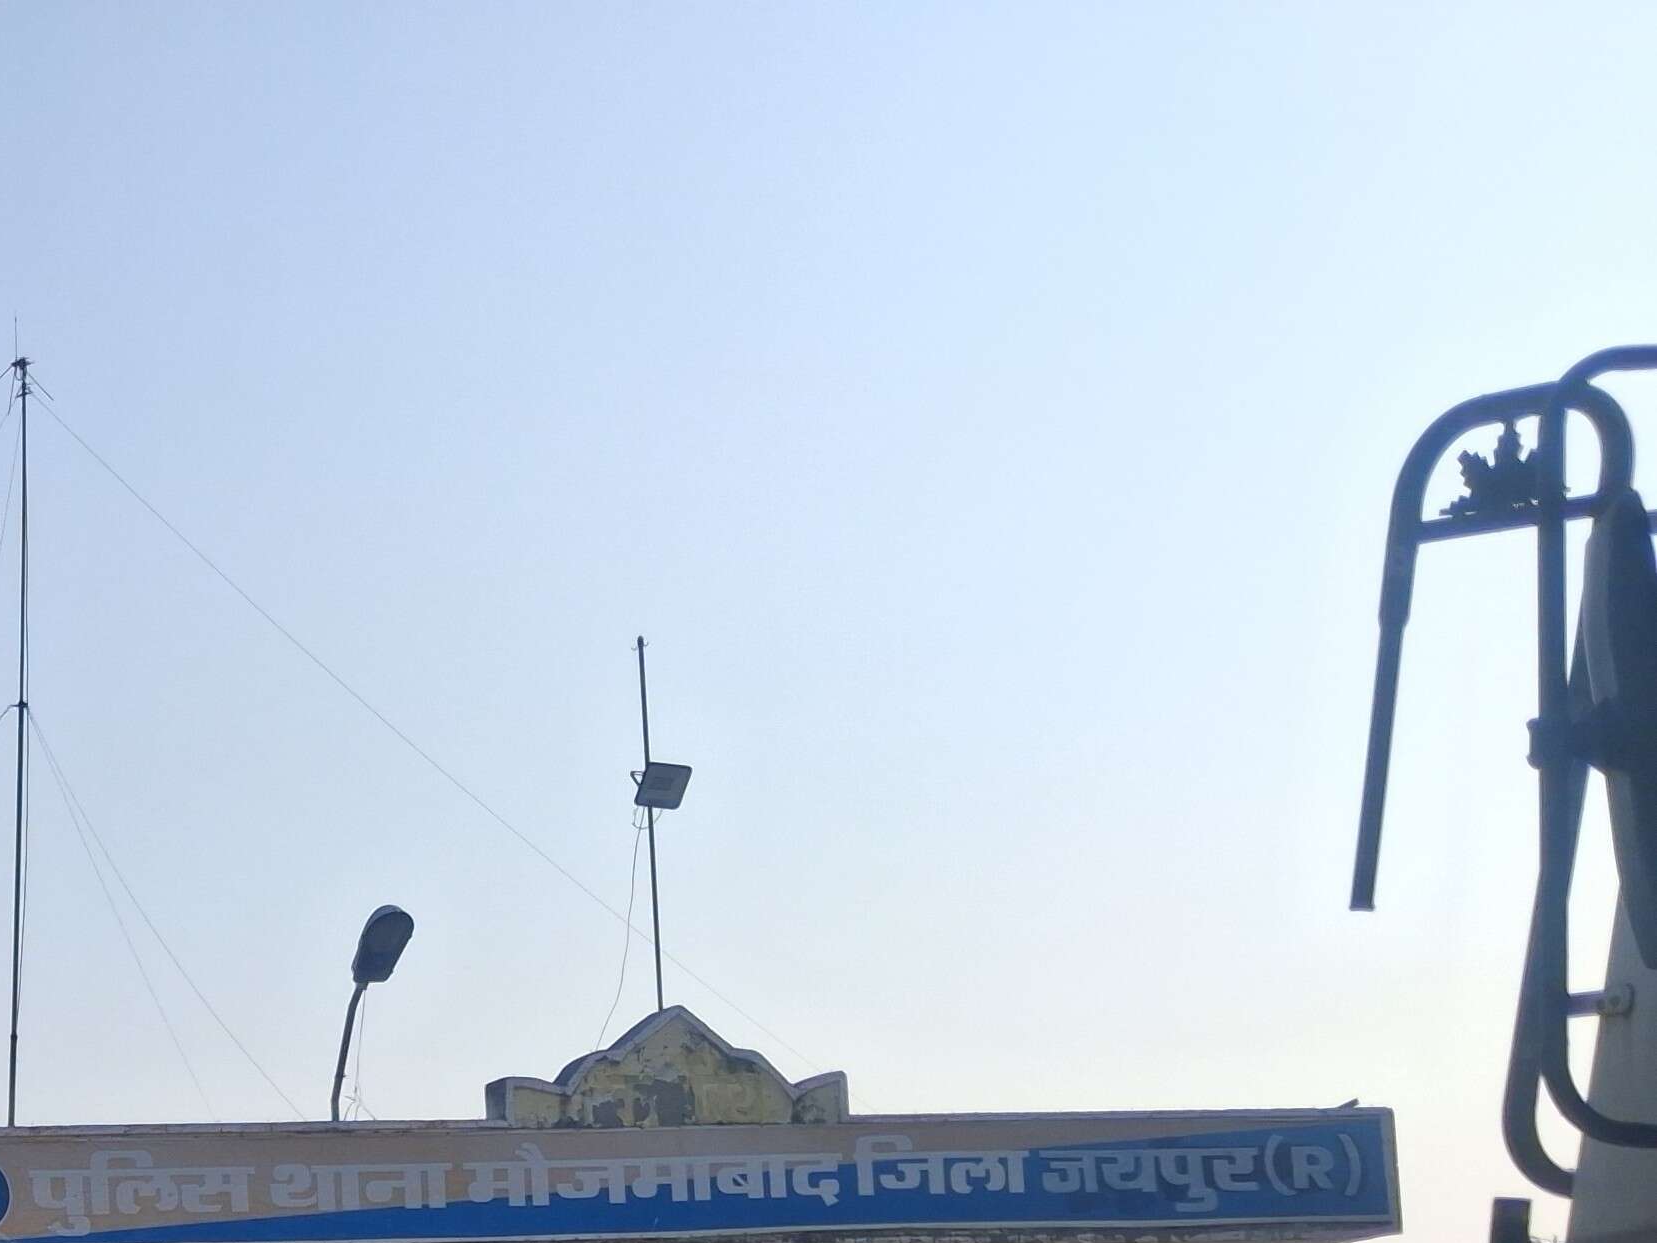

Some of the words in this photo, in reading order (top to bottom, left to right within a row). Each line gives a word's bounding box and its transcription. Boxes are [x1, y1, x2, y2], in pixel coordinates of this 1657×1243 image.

[29, 1150, 255, 1236] पुलिस
[270, 1162, 452, 1210] थाना
[854, 1134, 1030, 1196] जिला
